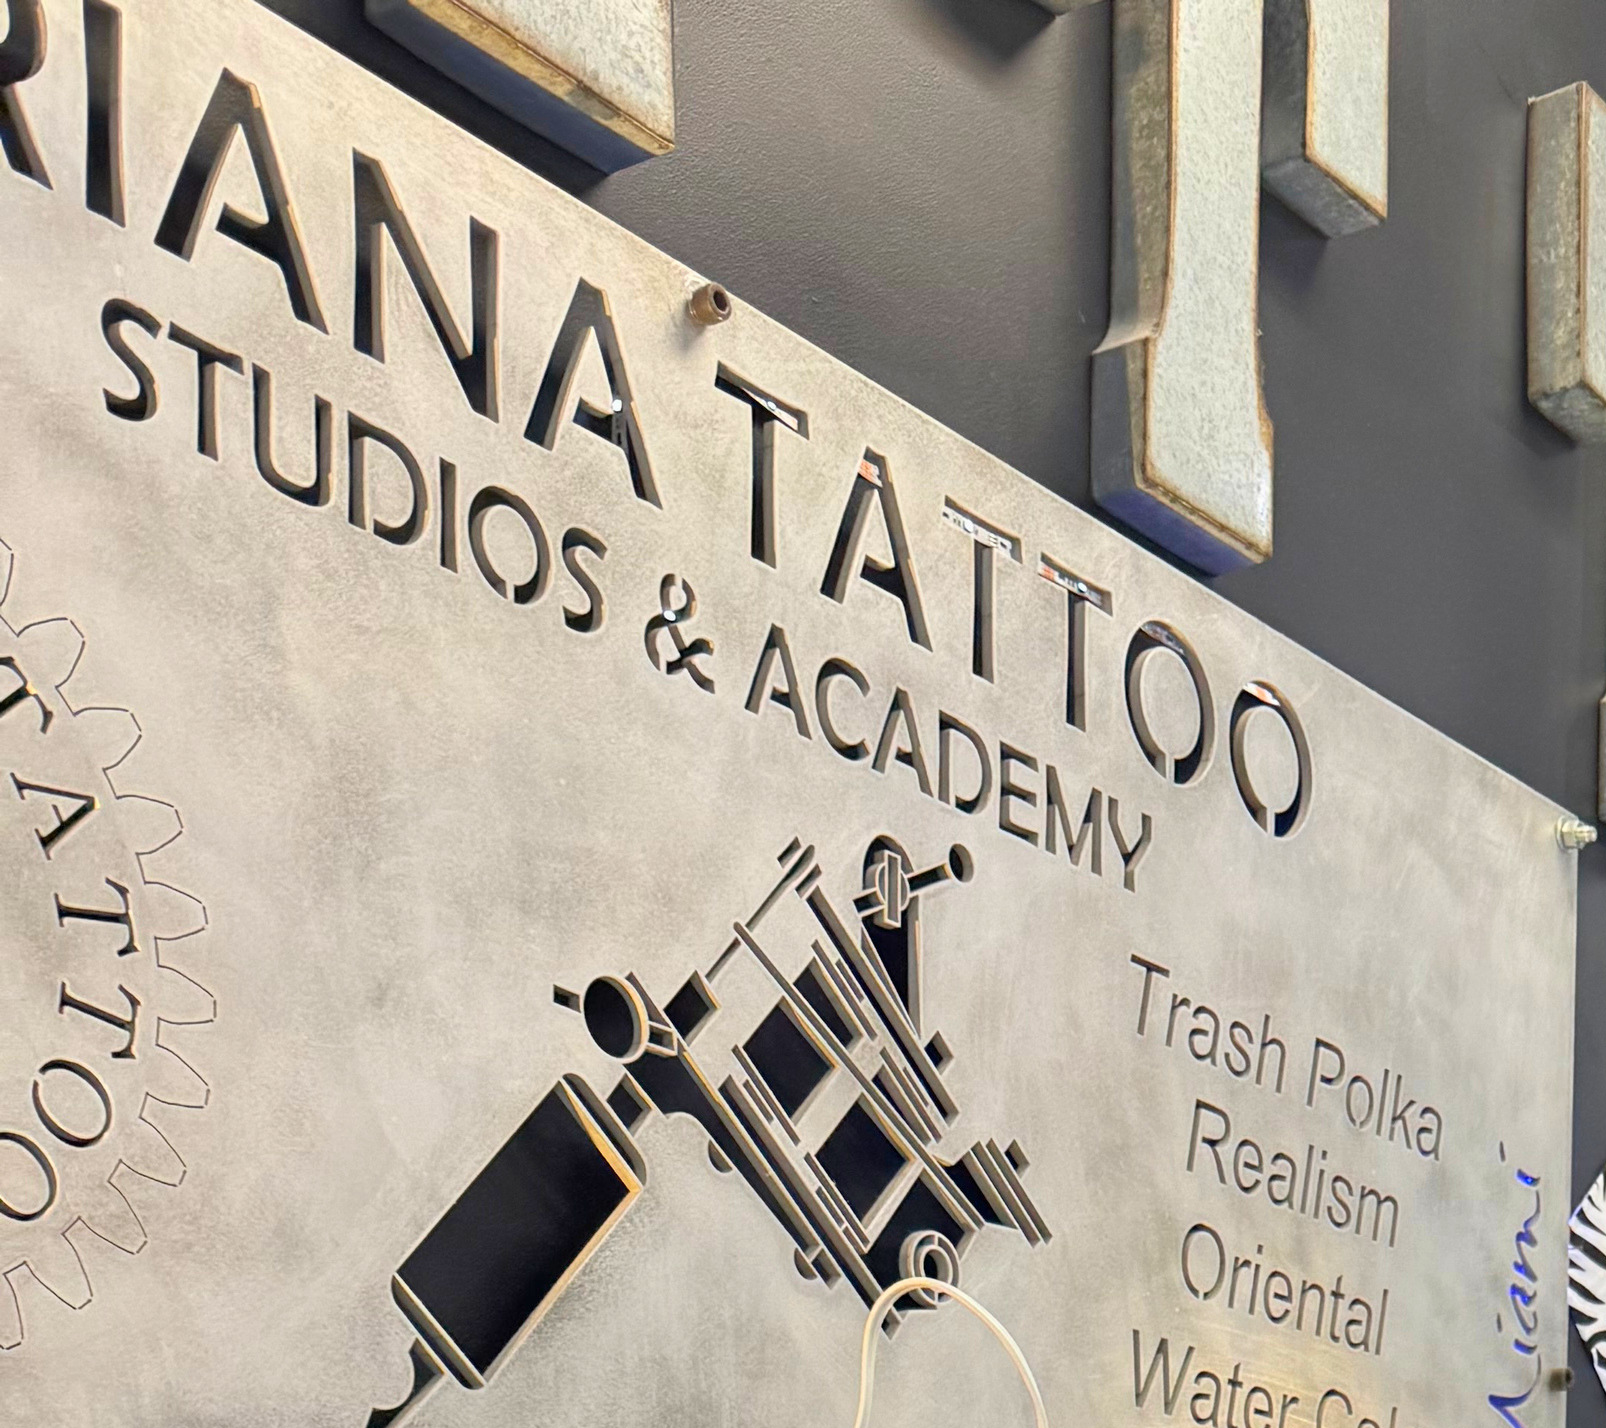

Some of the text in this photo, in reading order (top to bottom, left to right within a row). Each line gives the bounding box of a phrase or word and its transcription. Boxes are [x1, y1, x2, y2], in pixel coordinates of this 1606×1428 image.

[101, 297, 1153, 893] STUDIOS & ACADEMY
[715, 360, 1313, 839] TATTOO
[1130, 953, 1444, 1162] Trash Polka
[1186, 1098, 1400, 1249] Realism
[1180, 1222, 1390, 1356] Oriental
